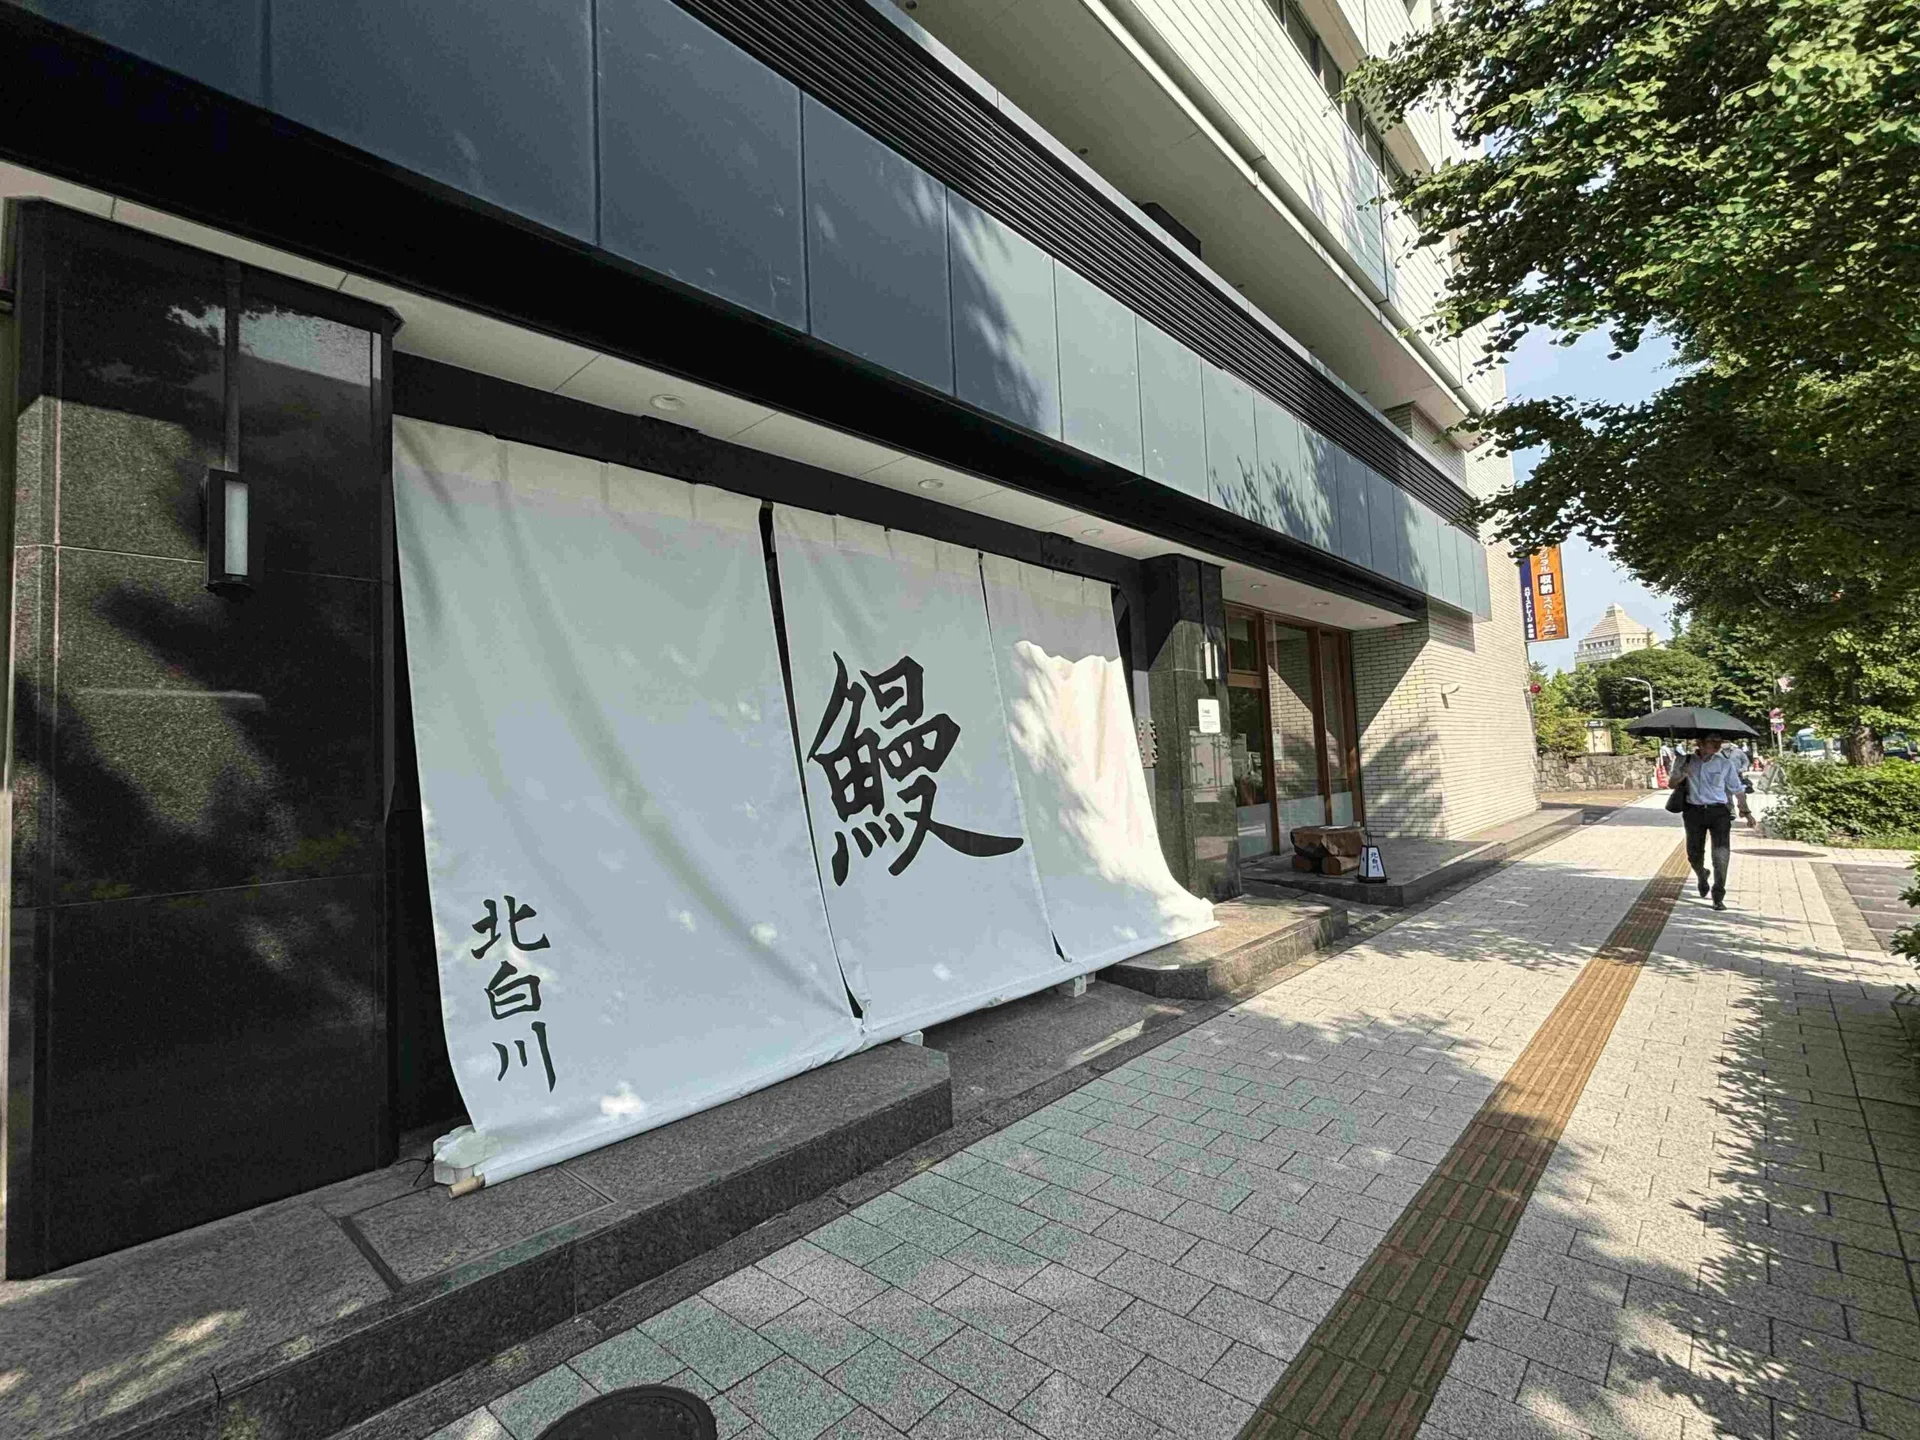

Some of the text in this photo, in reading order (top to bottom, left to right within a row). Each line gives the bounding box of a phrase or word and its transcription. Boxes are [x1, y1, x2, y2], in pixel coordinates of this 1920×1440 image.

[806, 651, 1024, 886] 鰻
[1370, 851, 1380, 872] 北白川
[470, 895, 556, 1093] 北白川
